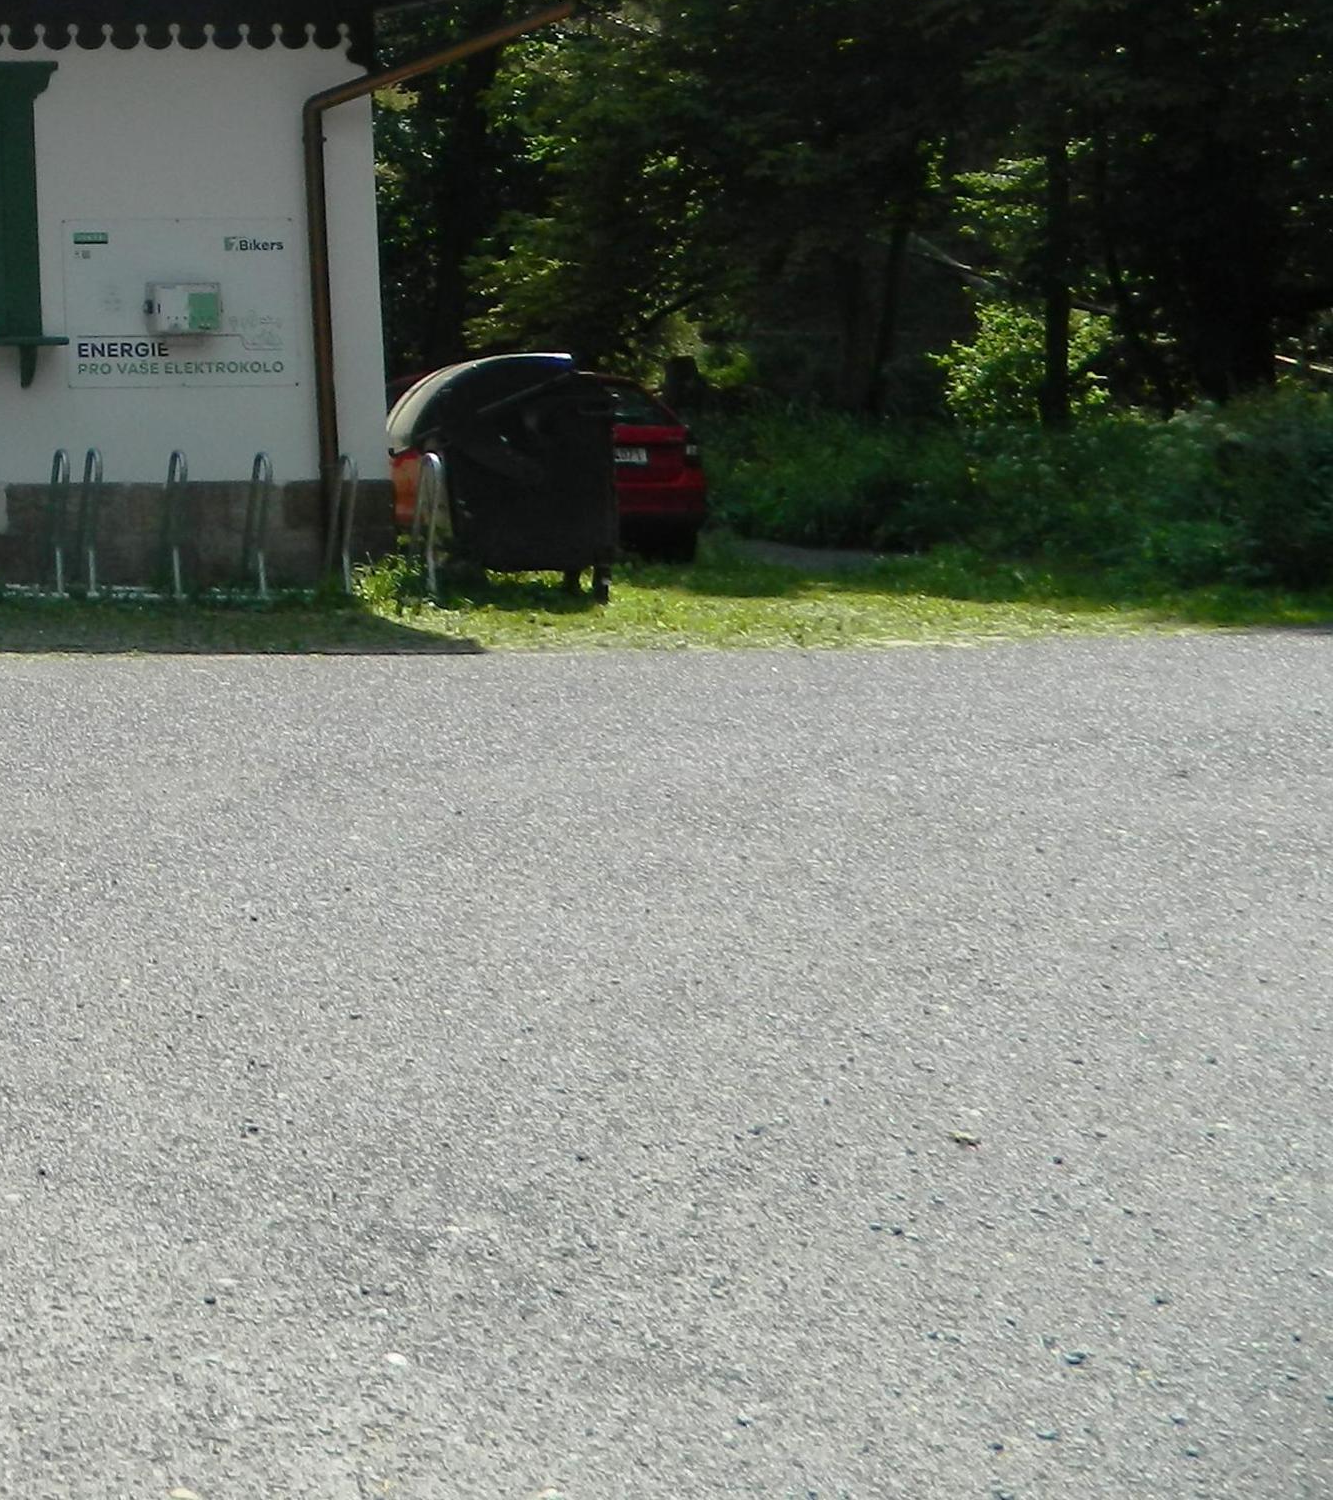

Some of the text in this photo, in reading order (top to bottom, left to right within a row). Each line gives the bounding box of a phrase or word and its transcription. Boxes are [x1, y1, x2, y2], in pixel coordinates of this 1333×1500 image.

[78, 342, 170, 358] ENERGIE
[77, 361, 285, 375] PRO VAŠE ELEKTROKOLO
